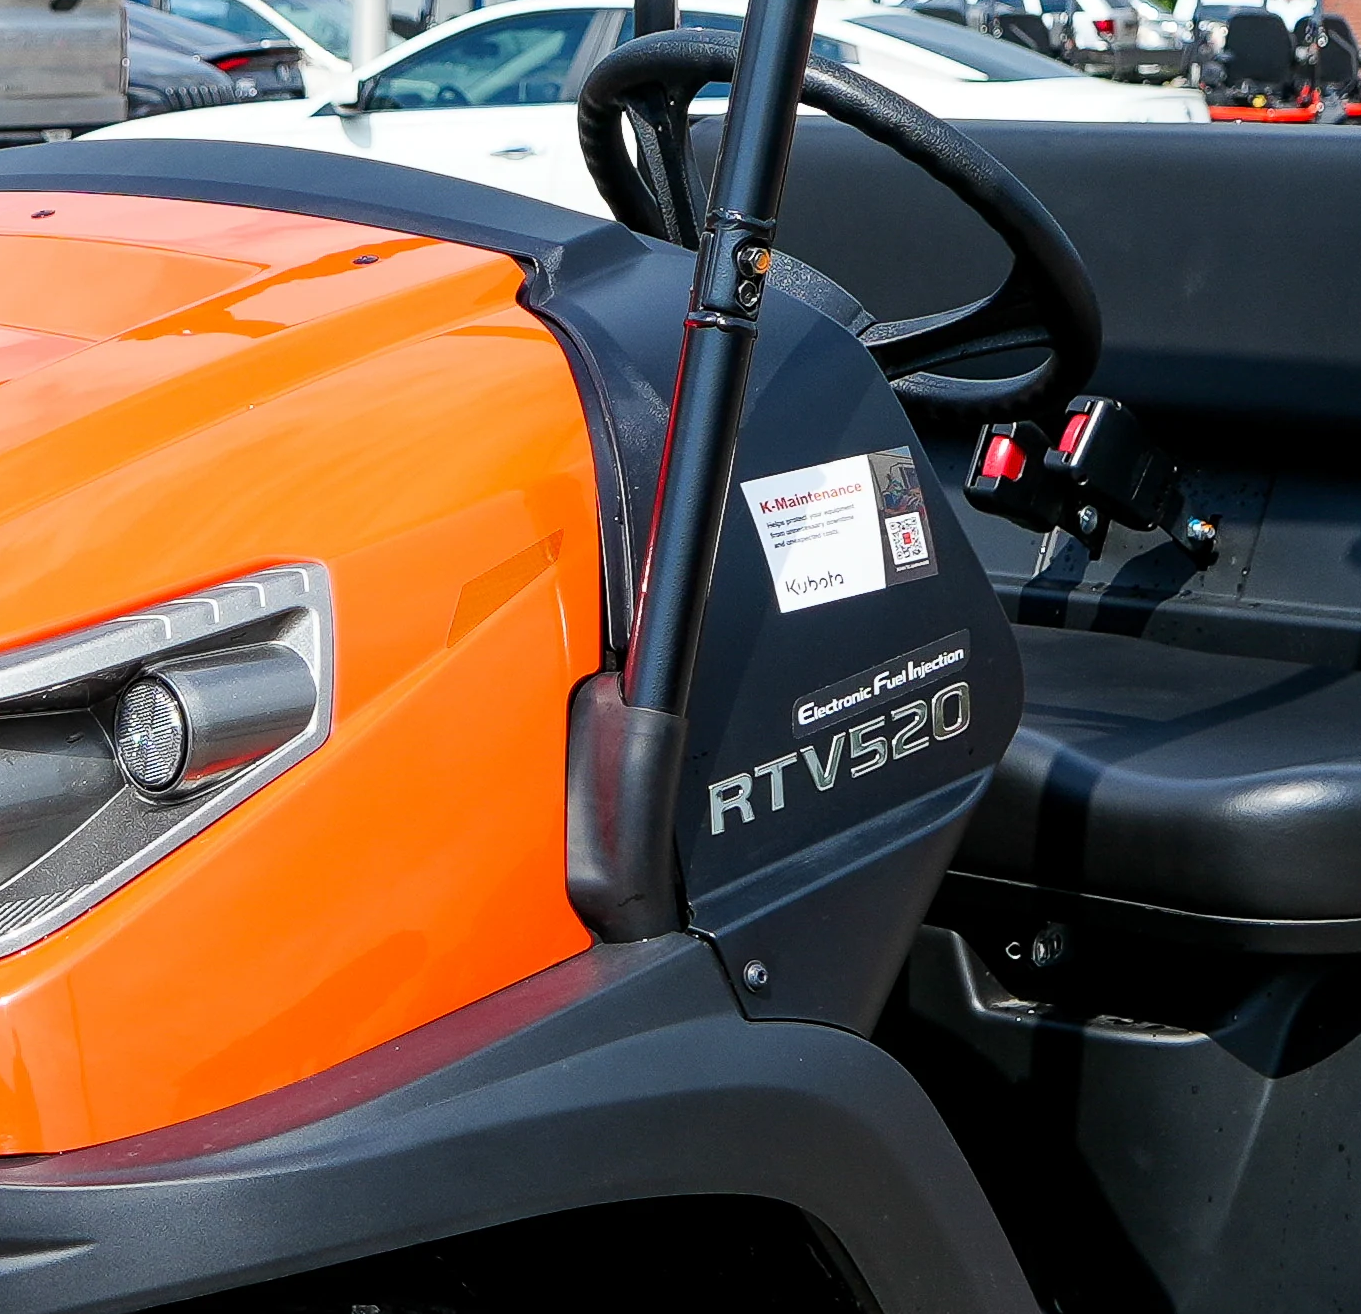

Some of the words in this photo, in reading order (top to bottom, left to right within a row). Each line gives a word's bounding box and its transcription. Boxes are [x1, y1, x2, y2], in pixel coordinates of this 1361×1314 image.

[759, 481, 863, 514] K-Maintenance
[785, 570, 845, 596] Kubota
[797, 685, 872, 726] Electronic
[873, 668, 907, 697] Fuel
[906, 646, 965, 684] Injection
[708, 681, 971, 837] RTV520
